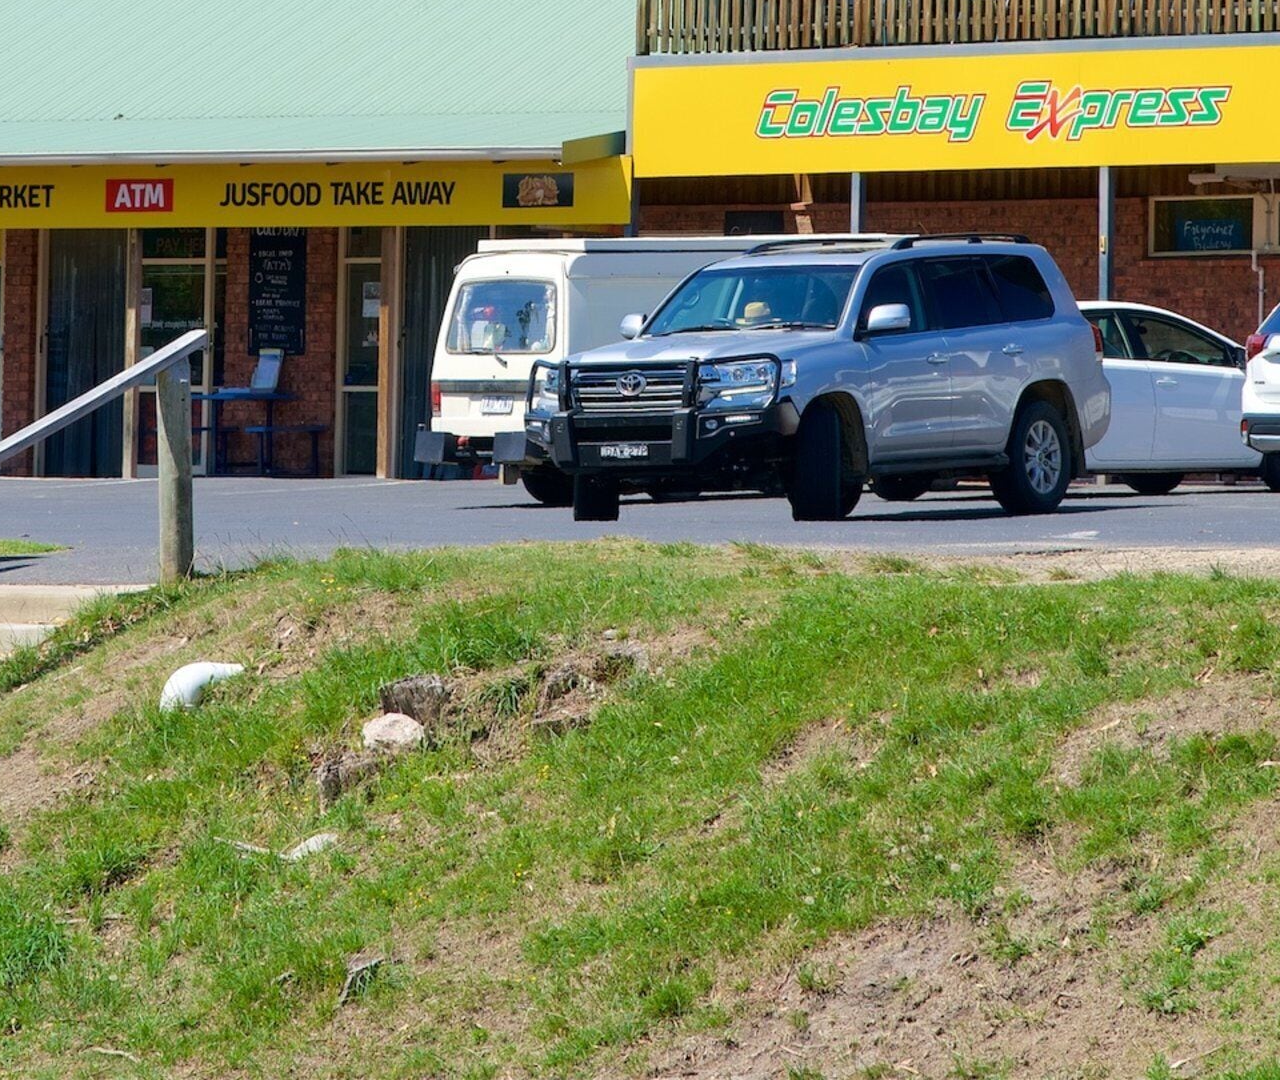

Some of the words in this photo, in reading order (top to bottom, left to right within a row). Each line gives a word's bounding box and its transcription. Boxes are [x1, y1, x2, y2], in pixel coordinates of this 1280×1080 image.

[756, 84, 987, 143] Colesbay
[1006, 79, 1232, 142] Express
[114, 183, 165, 208] ATM
[220, 182, 321, 206] JUSFOOD
[330, 181, 384, 205] TAKE
[392, 181, 456, 205] AWAY
